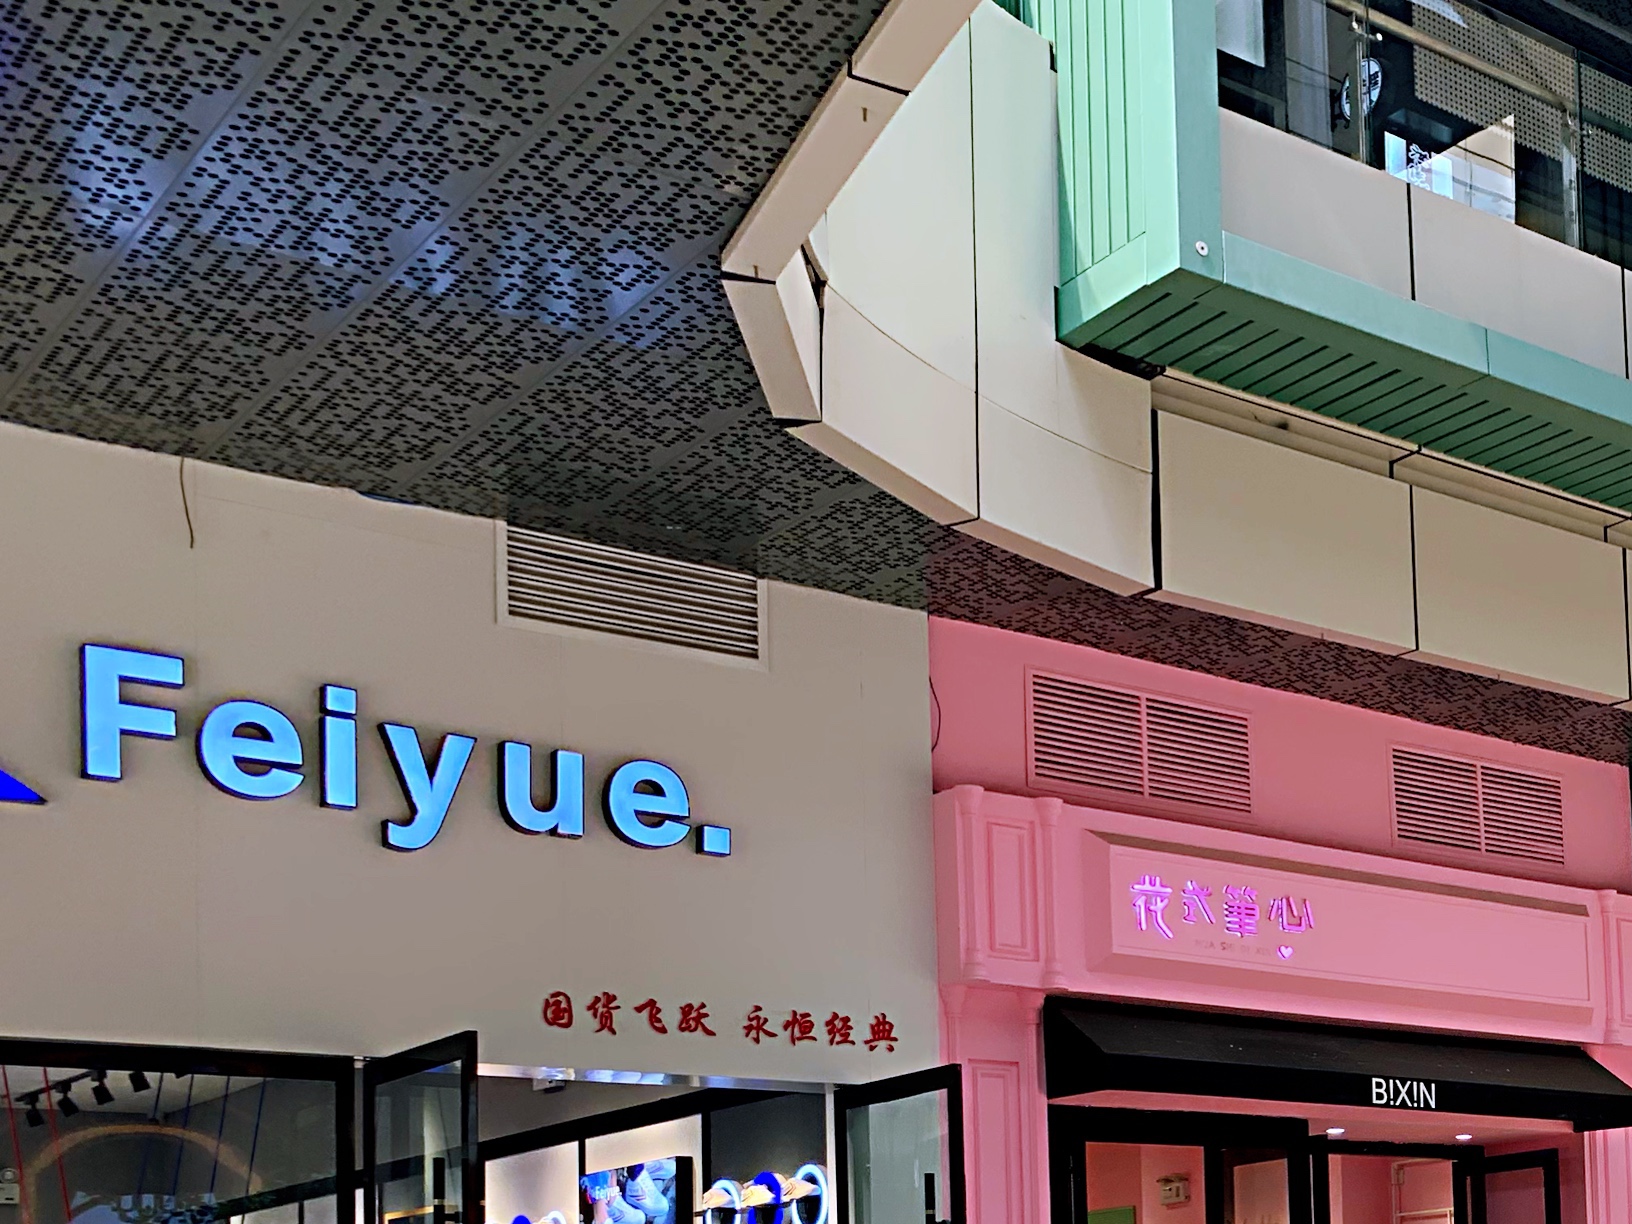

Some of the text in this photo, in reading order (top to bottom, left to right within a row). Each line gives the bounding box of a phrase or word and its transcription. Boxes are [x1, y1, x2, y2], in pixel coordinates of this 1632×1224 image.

[79, 643, 731, 858] Feiyue.
[542, 990, 899, 1053] 国货飞跃 永恒经典
